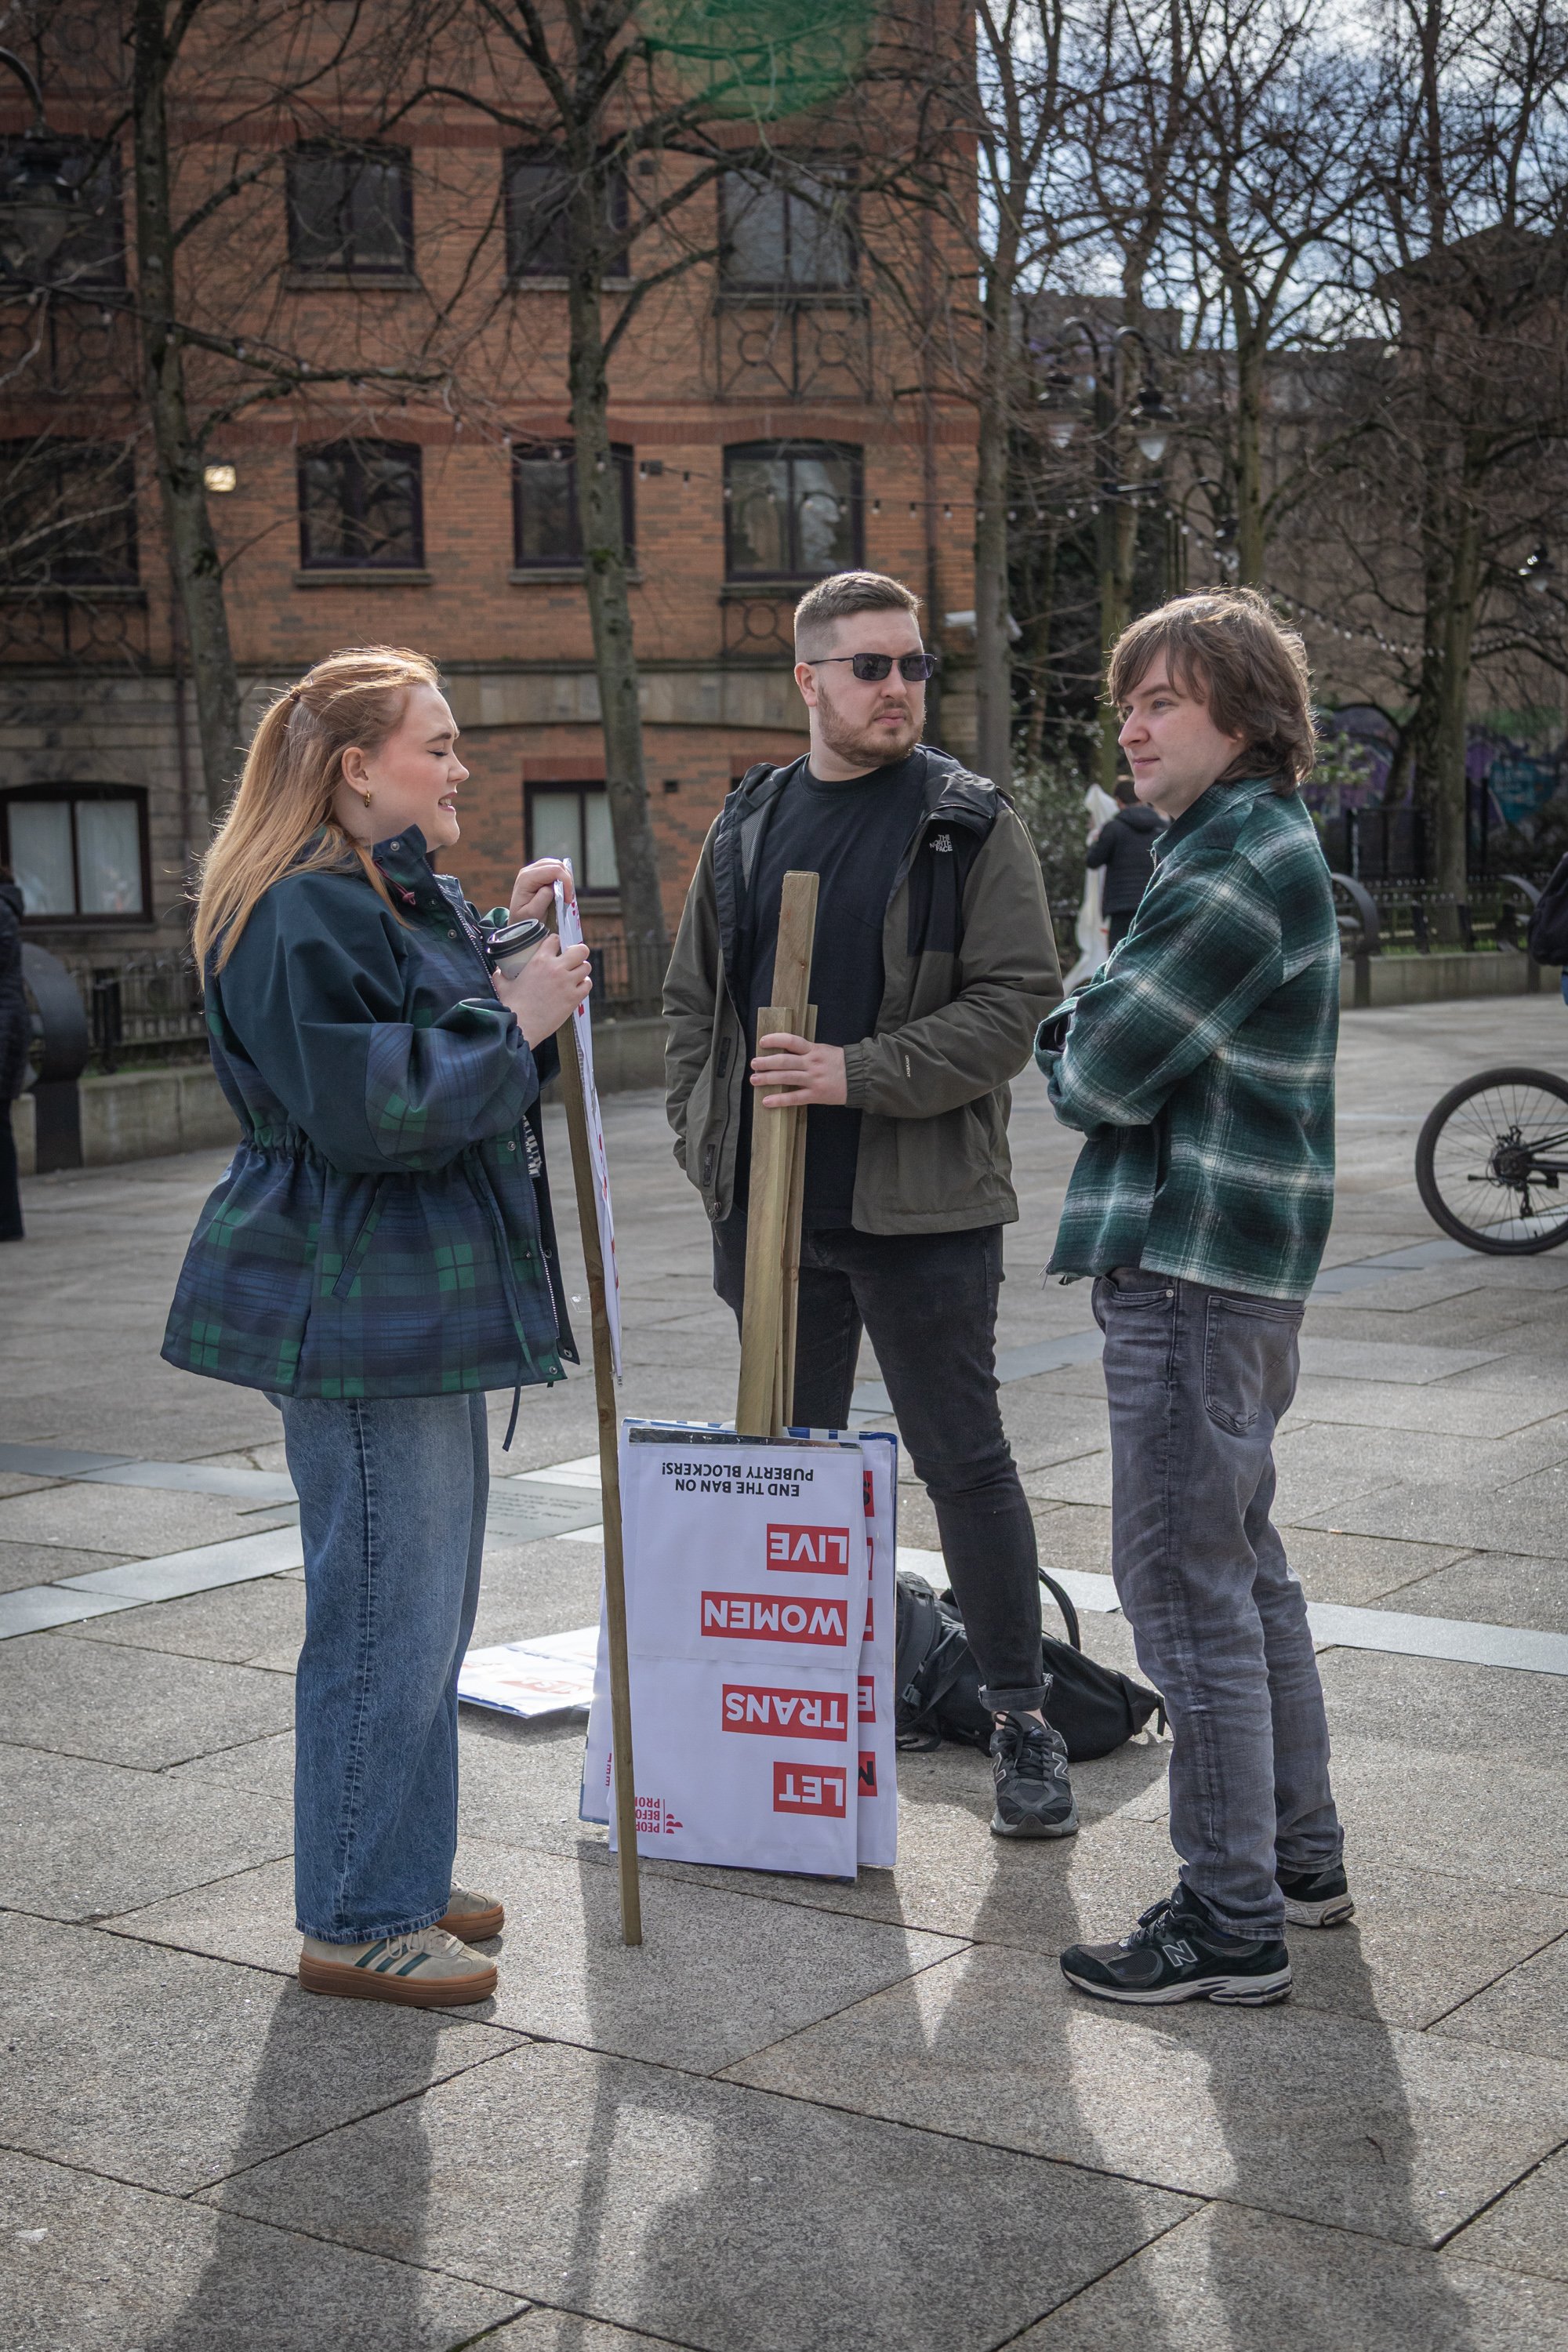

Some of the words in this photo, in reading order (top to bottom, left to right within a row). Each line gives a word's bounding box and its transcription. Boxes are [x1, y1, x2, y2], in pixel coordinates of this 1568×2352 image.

[929, 840, 952, 848] NORTH
[662, 1462, 742, 1477] BLOCKERS!
[746, 1466, 814, 1482] PUBERTY
[675, 1479, 696, 1492] ON
[700, 1479, 731, 1494] BAN
[736, 1481, 764, 1495] THE
[768, 1483, 800, 1497] END
[770, 1531, 848, 1564] LIVE
[704, 1599, 844, 1636] WOMEN
[725, 1692, 845, 1730] TRANS
[779, 1773, 844, 1807] LET
[634, 1809, 660, 1820] BEFO
[635, 1821, 660, 1833] PEOP
[1162, 1940, 1198, 1967] N
